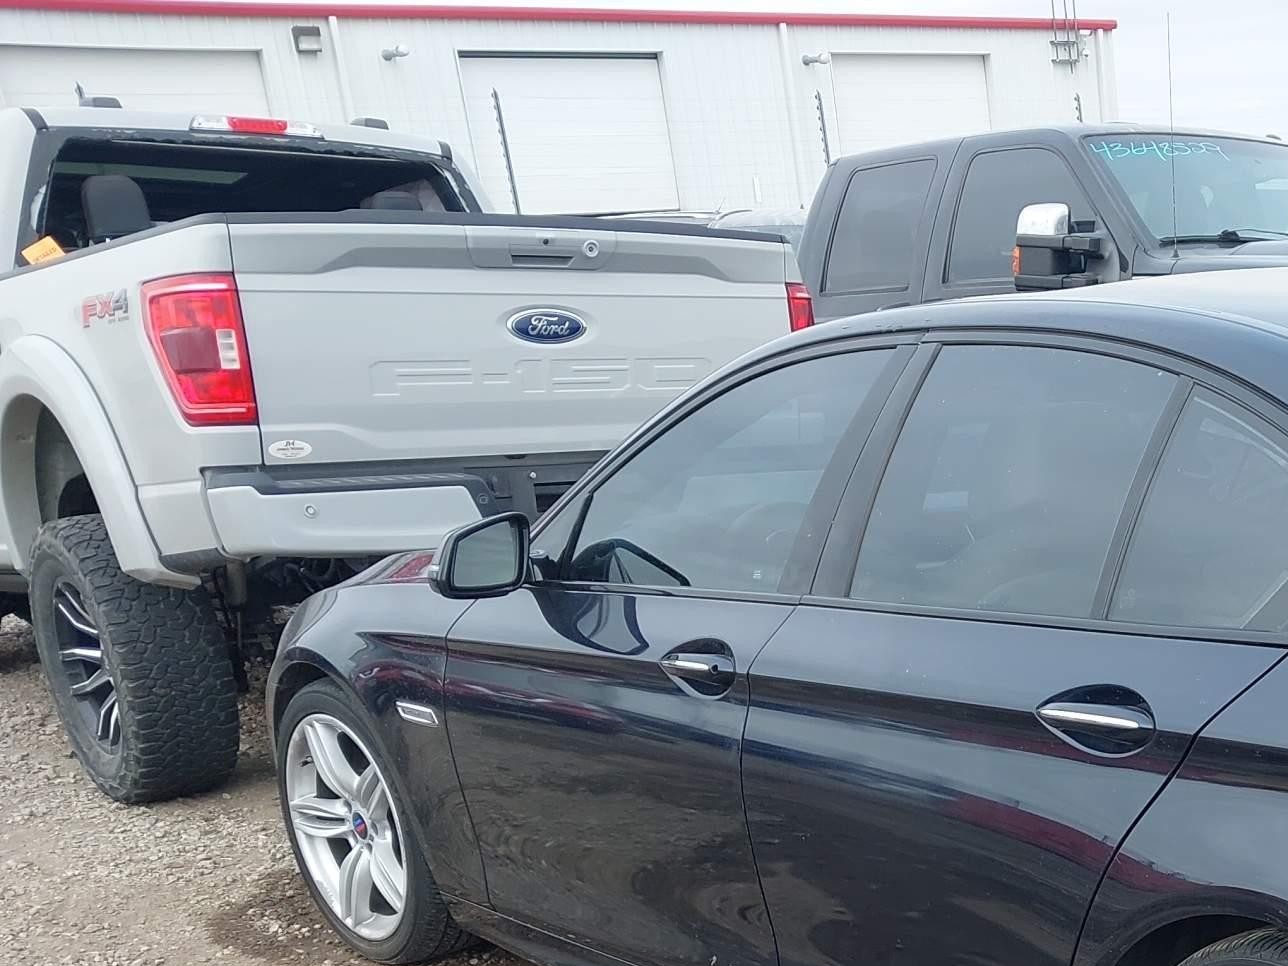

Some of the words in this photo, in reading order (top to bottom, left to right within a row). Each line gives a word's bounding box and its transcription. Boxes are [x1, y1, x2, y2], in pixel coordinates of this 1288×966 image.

[81, 287, 129, 328] FX4
[527, 315, 571, 335] Ford
[368, 356, 713, 396] F-150
